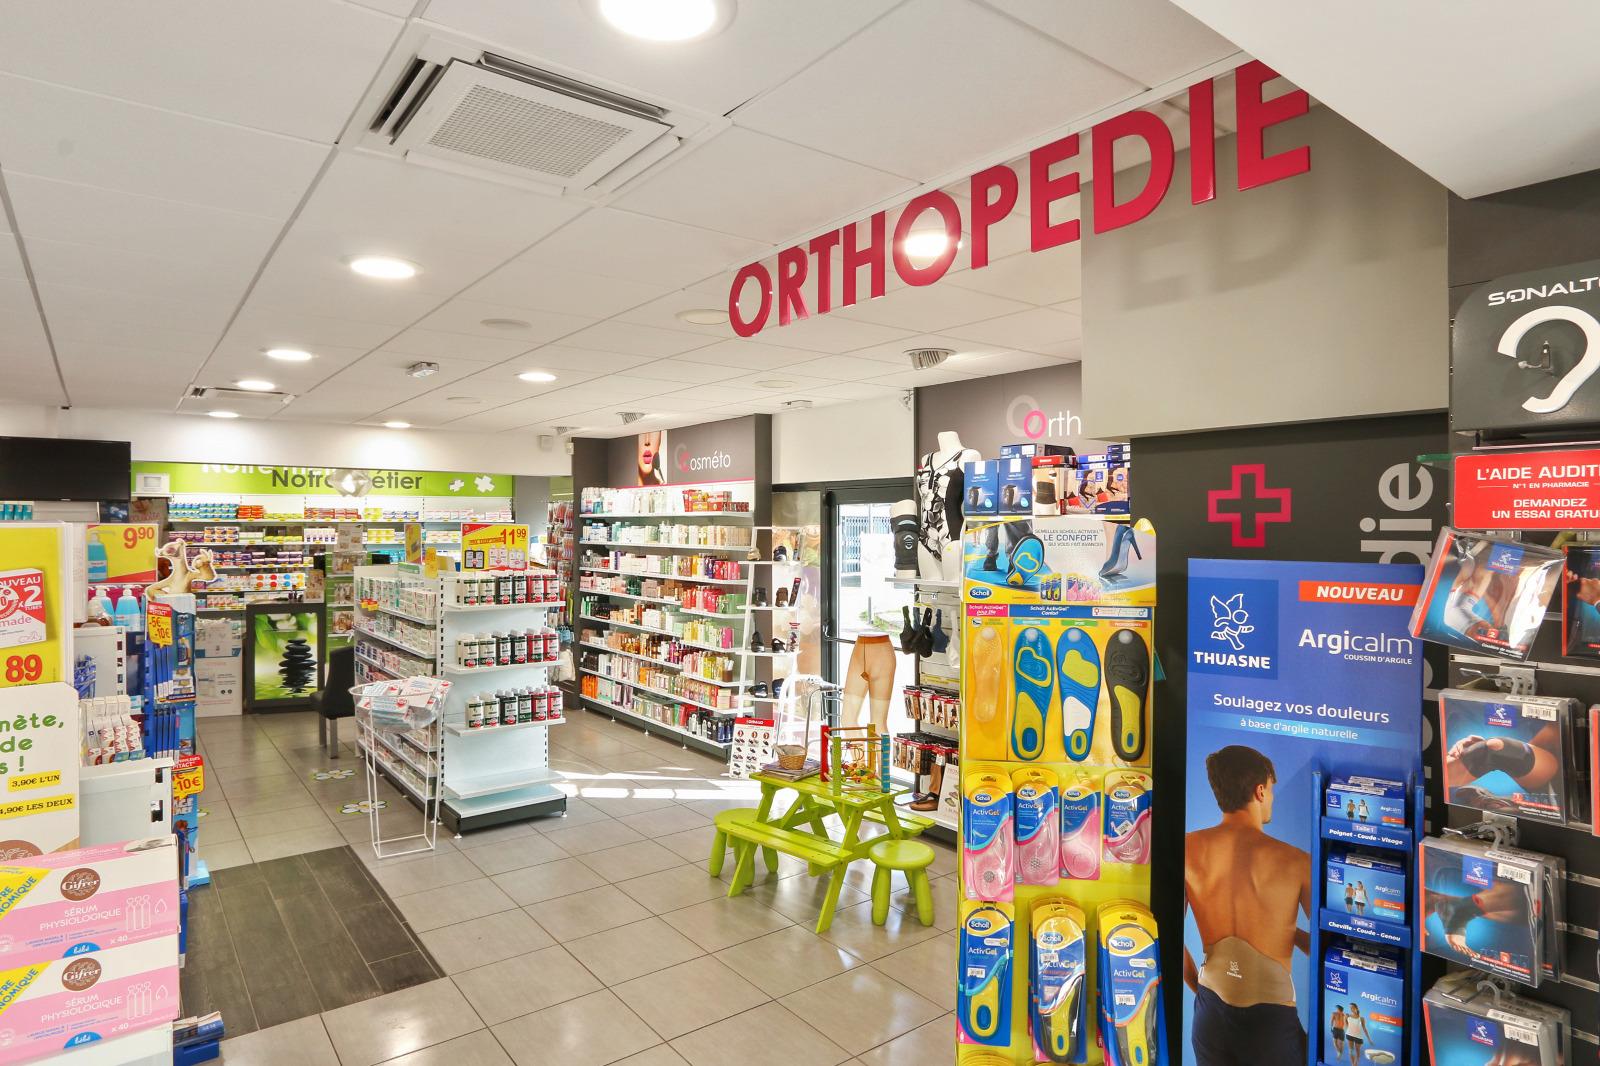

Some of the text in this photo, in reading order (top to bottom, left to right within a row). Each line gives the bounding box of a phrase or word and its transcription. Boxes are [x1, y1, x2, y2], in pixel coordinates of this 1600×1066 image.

[729, 59, 1310, 337] ORTHOPEDIE
[1488, 276, 1600, 306] SONALT
[372, 470, 423, 489] étier
[1477, 467, 1532, 480] L'AIDE
[1513, 498, 1587, 507] DEMANDEZ
[1492, 509, 1600, 518] UN ESSAI GRATU
[1316, 585, 1404, 601] NOUVEAU
[1298, 629, 1413, 655] Argicalm
[1193, 651, 1271, 669] THUASNE
[1344, 654, 1412, 665] COUSSIN D'ARGILE
[5, 654, 43, 682] 89
[1213, 693, 1390, 723] Soulagez vos douleurs
[1240, 718, 1358, 740] à base d'argile naturelle
[0, 736, 33, 753] de
[26, 803, 44, 811] LES
[46, 798, 73, 808] DEUX
[972, 808, 1000, 816] ActivGel
[1329, 828, 1403, 846] Poignet Coude Visage
[61, 879, 100, 892] Gifrer
[64, 904, 98, 917] SÉRUM
[39, 908, 121, 931] PHYSIOLOGIQUE
[970, 921, 990, 929] Scholl
[1328, 921, 1401, 942] Cheville Coude Genou
[1113, 939, 1134, 948] choll
[968, 947, 998, 955] ActivGel
[62, 968, 101, 981] Gifrer
[1113, 969, 1146, 978] ActivGel
[65, 994, 99, 1008] SÉRUM
[1360, 991, 1397, 1005] Argicalm
[41, 996, 122, 1023] PHYSIOLOGIQUE
